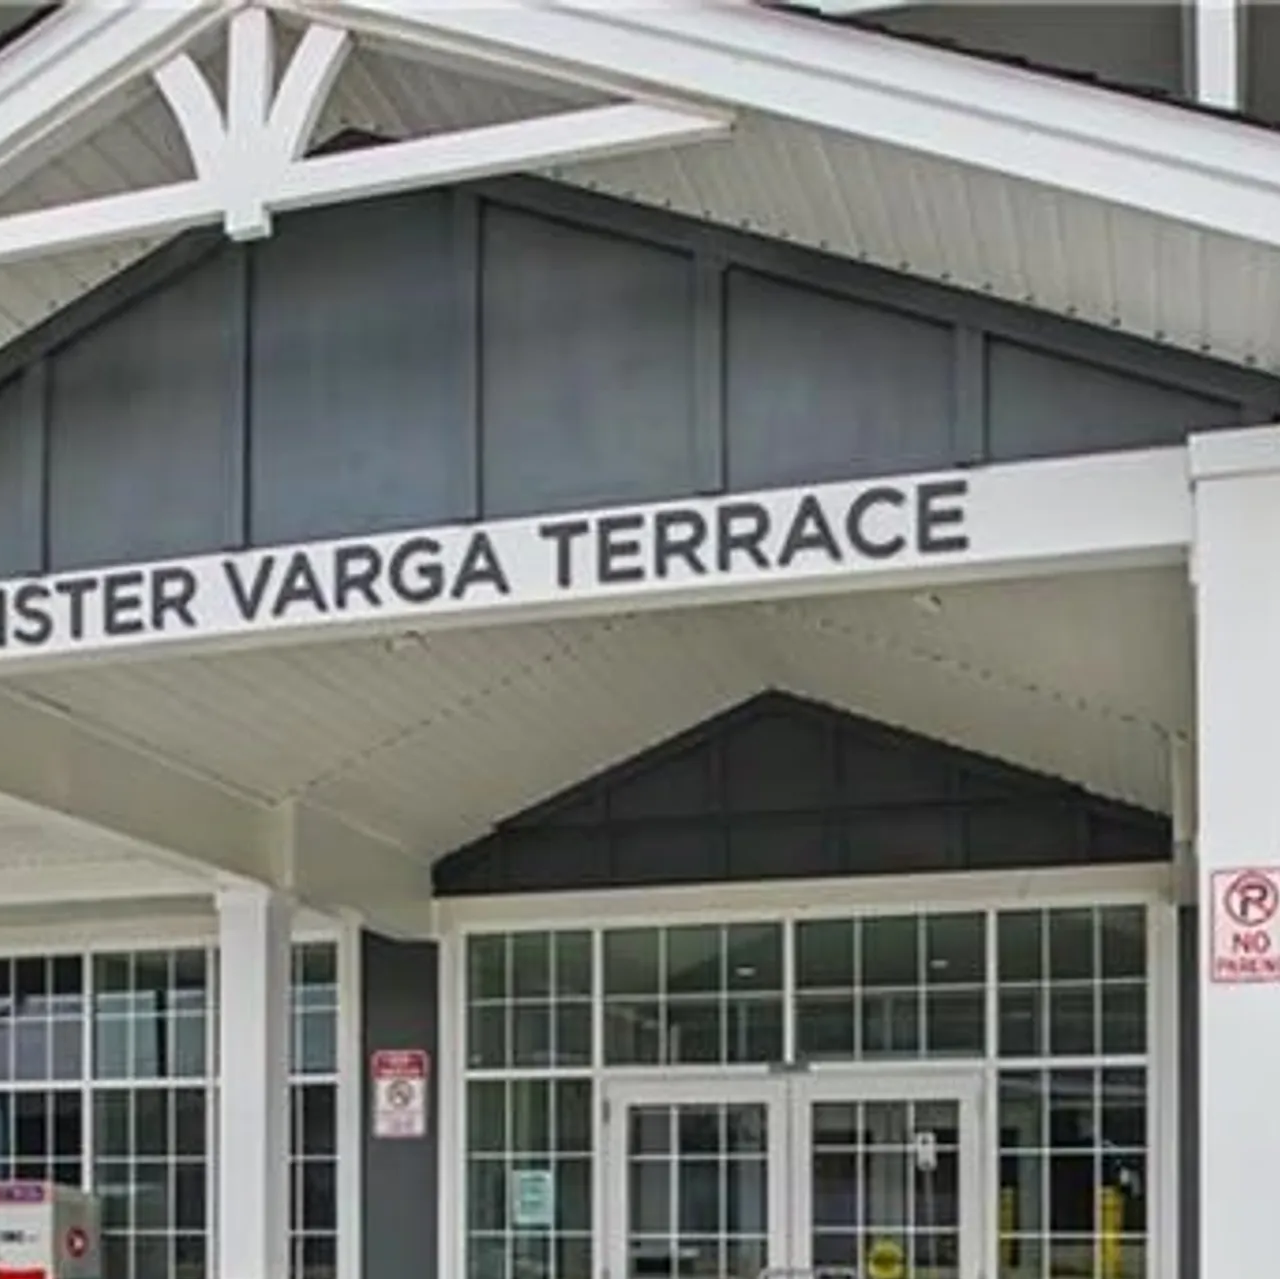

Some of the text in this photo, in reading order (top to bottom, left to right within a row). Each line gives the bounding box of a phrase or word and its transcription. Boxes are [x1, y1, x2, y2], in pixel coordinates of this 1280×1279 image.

[223, 531, 510, 622] VARGA
[539, 480, 970, 589] TERRACE
[1232, 930, 1272, 954] NO
